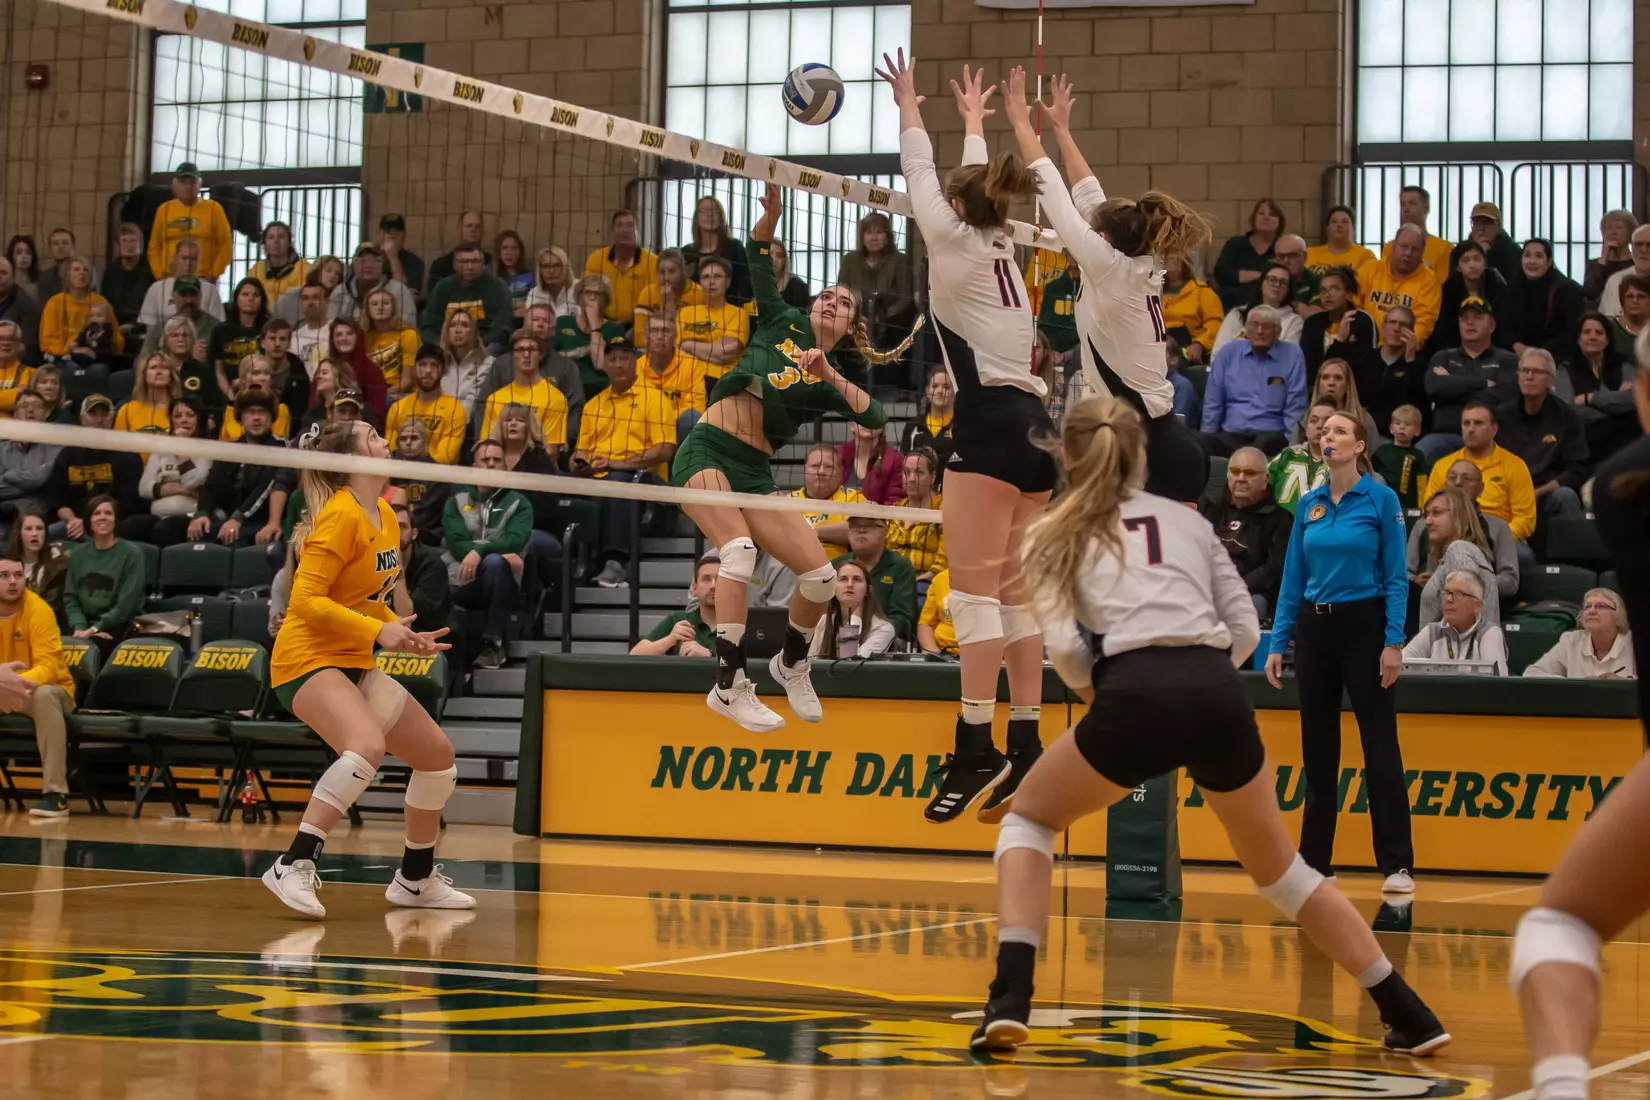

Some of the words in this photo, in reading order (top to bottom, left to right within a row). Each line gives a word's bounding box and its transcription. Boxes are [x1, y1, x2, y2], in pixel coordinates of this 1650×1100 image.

[231, 23, 270, 49] BISON
[348, 52, 382, 76] BISON
[453, 80, 485, 104] BISON
[550, 106, 580, 128] BISON
[639, 129, 666, 149] BISON
[721, 150, 747, 171] BISON
[867, 188, 891, 206] BISON
[993, 259, 1022, 308] 11
[1369, 291, 1413, 308] NDSU
[1122, 515, 1162, 565] 7
[376, 545, 400, 572] NDS
[112, 649, 172, 668] BISON
[194, 651, 256, 671] BISON
[375, 656, 435, 677] BISON
[650, 745, 832, 794] NORTH
[845, 752, 948, 799] DAK
